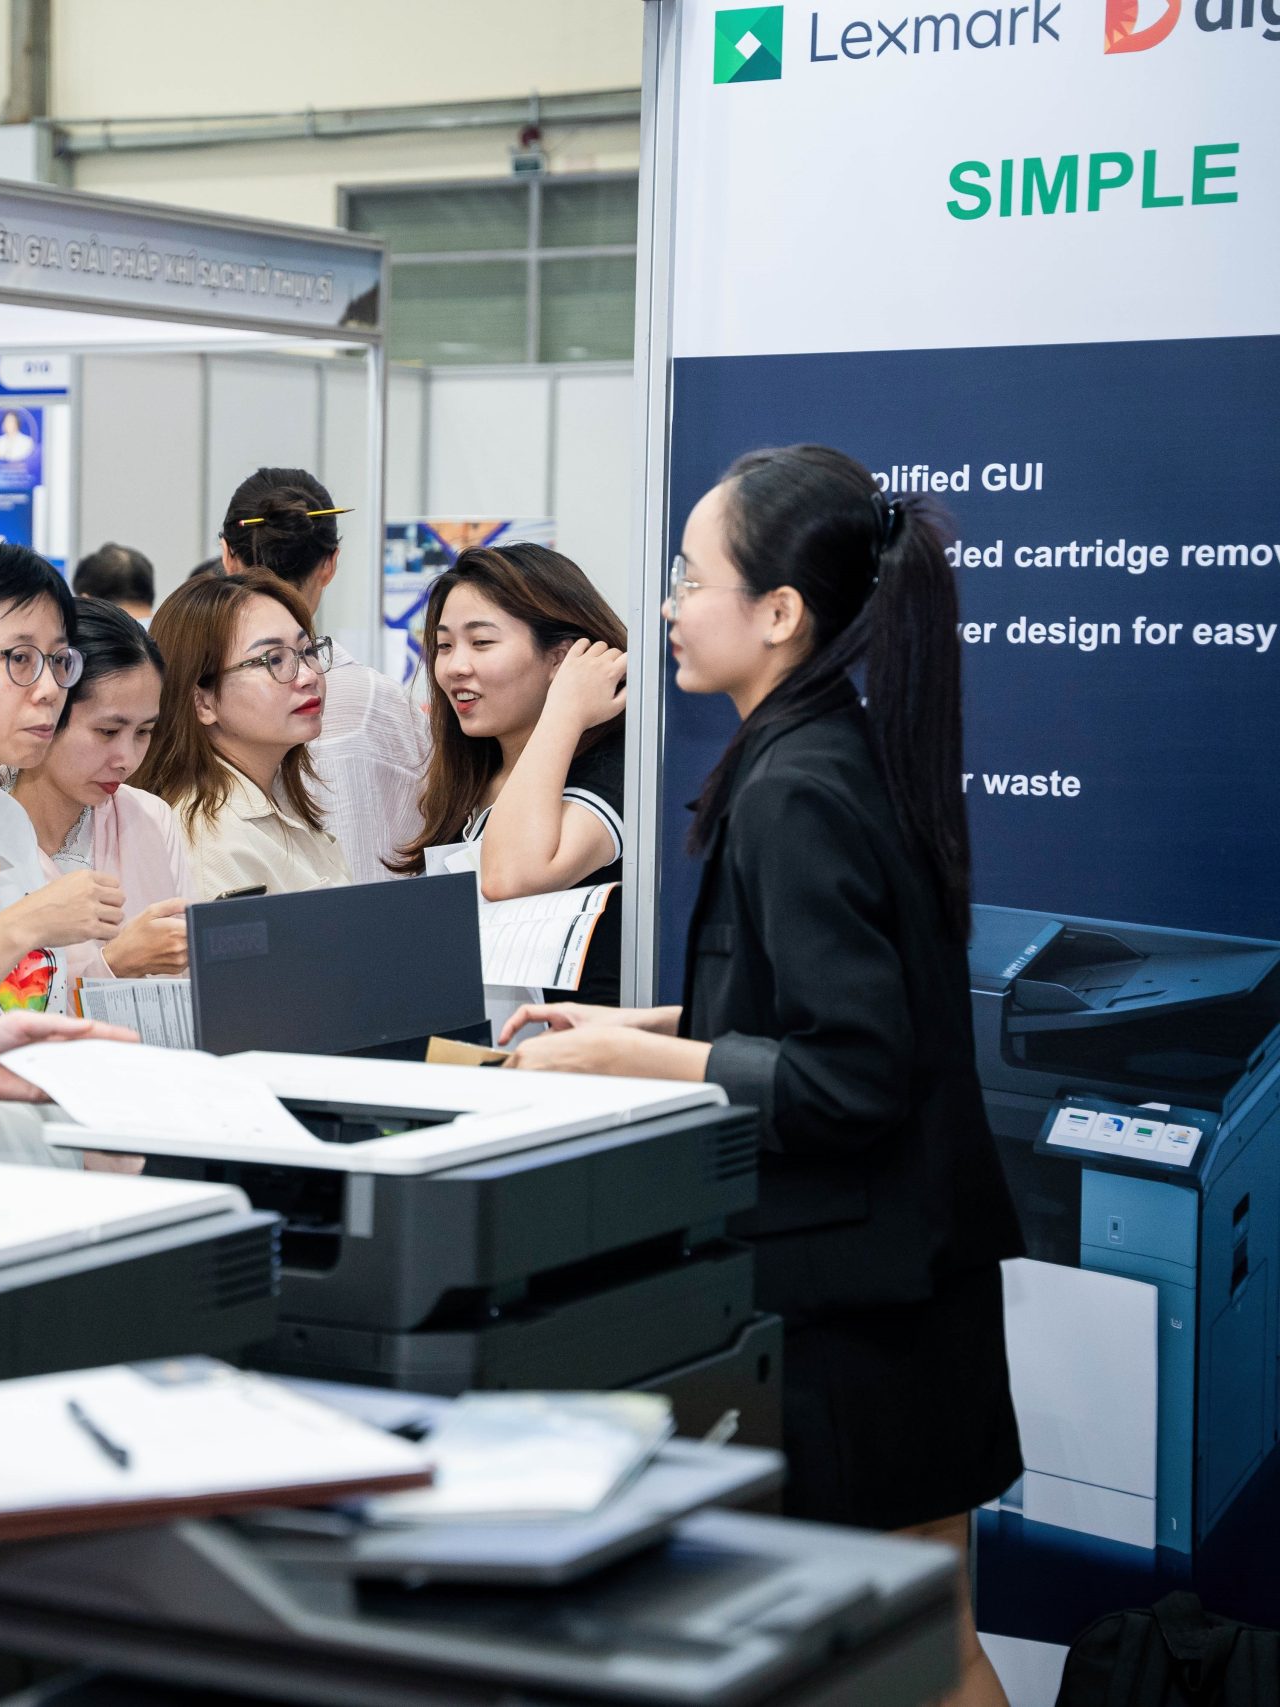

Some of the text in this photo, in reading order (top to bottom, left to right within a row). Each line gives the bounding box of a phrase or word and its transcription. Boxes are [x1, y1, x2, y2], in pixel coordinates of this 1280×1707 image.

[810, 0, 1062, 62] Lexmark
[946, 142, 1240, 220] SIMPLE
[23, 234, 63, 270] GIA
[111, 241, 161, 281] PHÁP
[981, 462, 1043, 492] GUI
[1014, 539, 1169, 575] cartridge
[957, 616, 1278, 653] er design for easy
[982, 770, 1081, 797] waste
